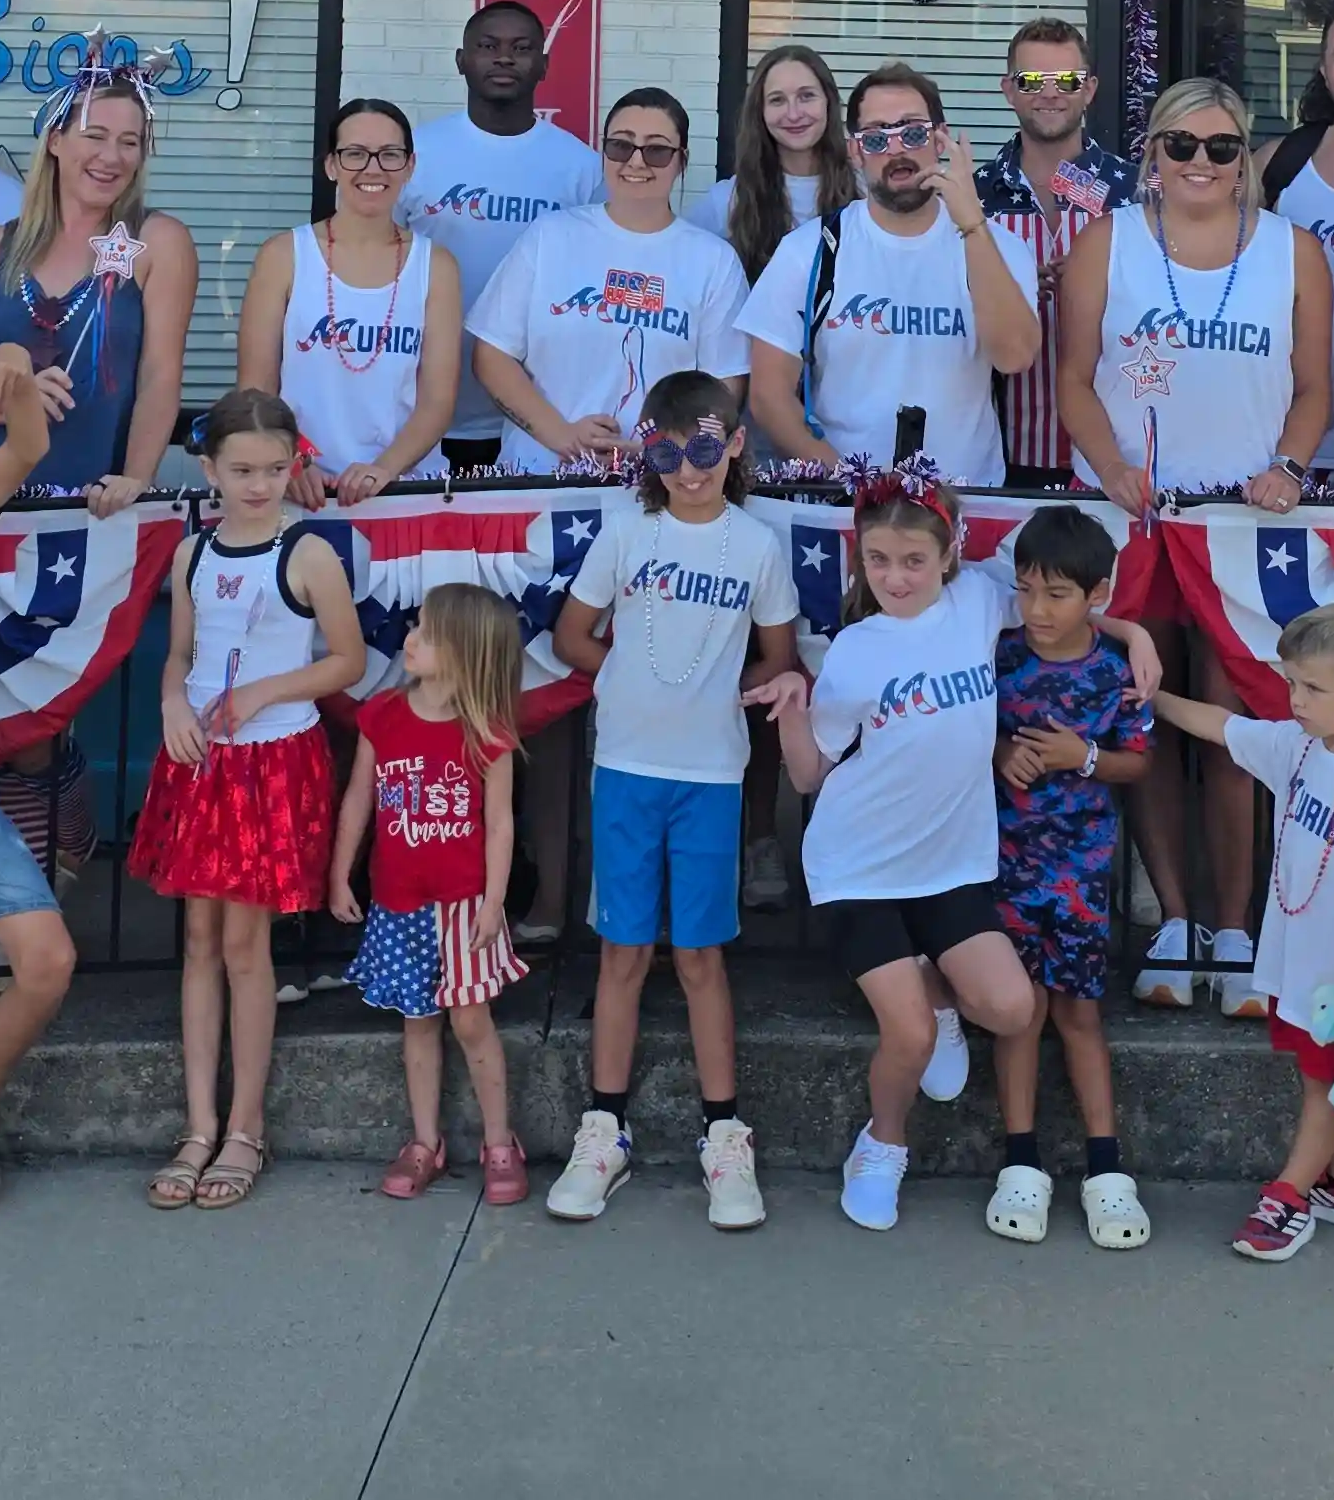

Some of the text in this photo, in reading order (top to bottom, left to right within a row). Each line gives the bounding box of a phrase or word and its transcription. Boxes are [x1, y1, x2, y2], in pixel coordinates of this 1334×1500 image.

[105, 252, 127, 263] USA
[604, 269, 664, 312] USA
[827, 294, 967, 338] MURICA
[1119, 307, 1270, 357] MURICA
[1139, 374, 1163, 385] USA
[624, 560, 750, 612] MURICA
[375, 755, 425, 778] LITTLE
[378, 775, 471, 817] MISS
[388, 808, 475, 848] America
